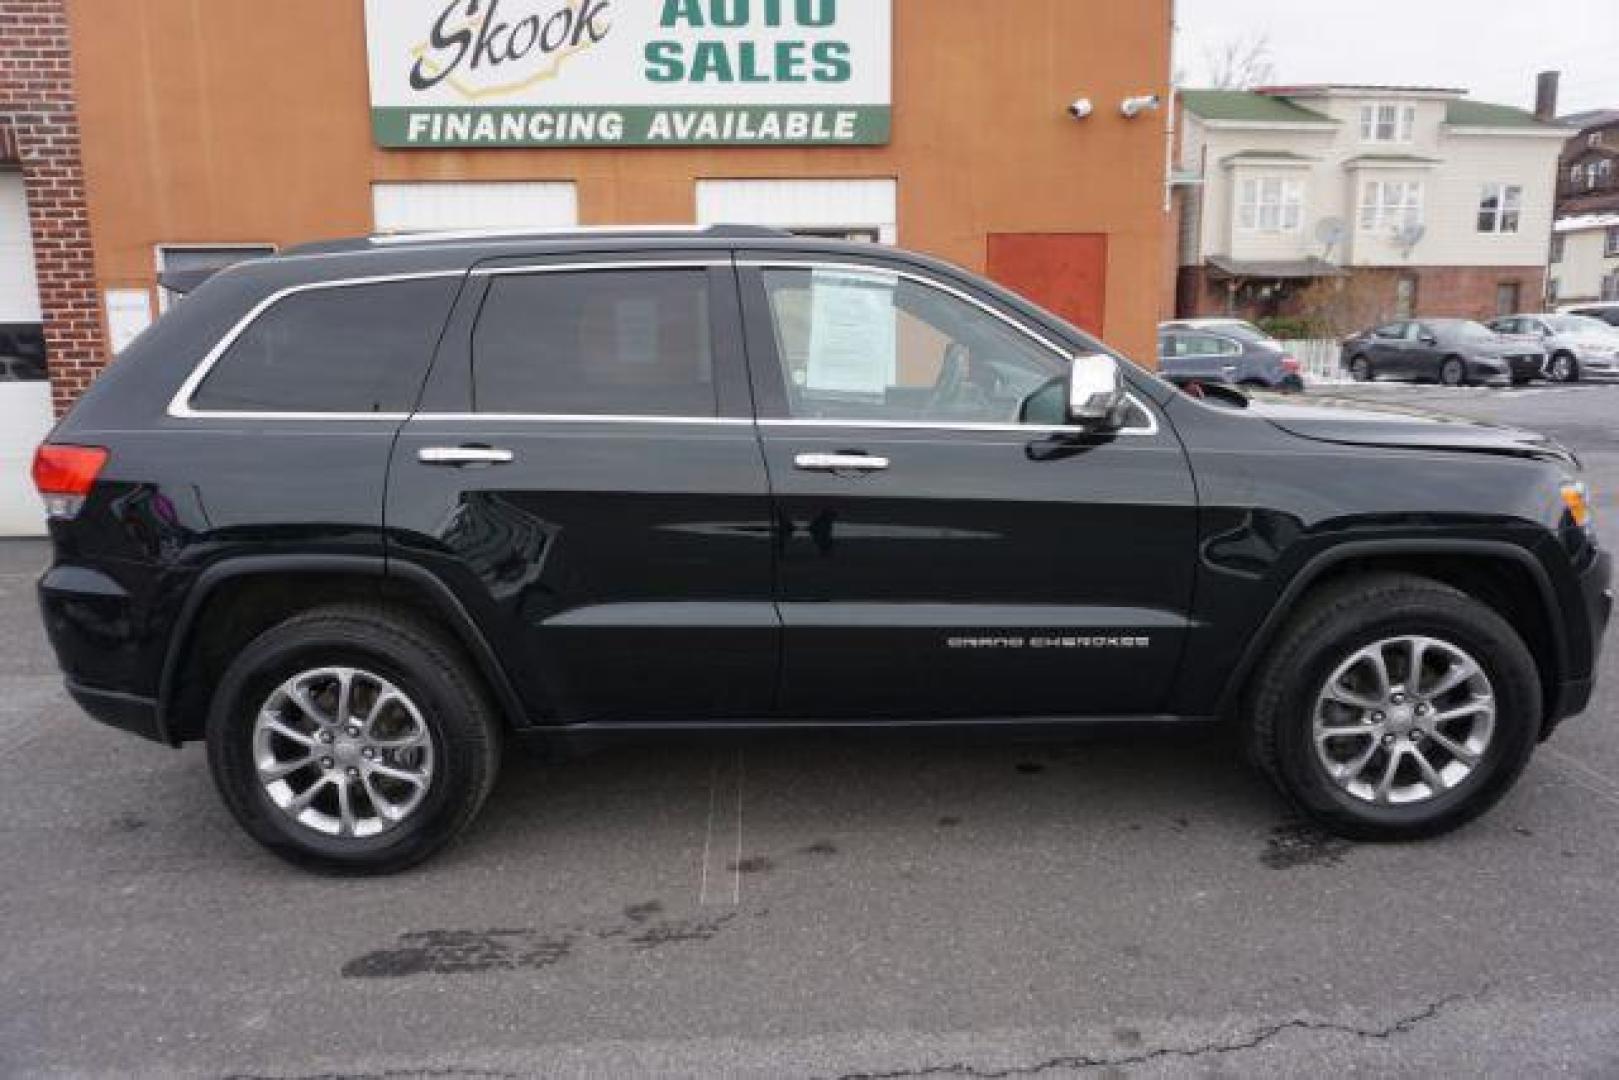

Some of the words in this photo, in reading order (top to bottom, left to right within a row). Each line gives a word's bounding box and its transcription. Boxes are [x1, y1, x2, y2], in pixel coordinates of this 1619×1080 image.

[409, 0, 612, 91] Skook
[644, 39, 852, 83] SALES
[407, 111, 624, 142] FINANCING
[648, 110, 858, 141] AVAILABLE
[1029, 636, 1150, 648] CHEROKEE
